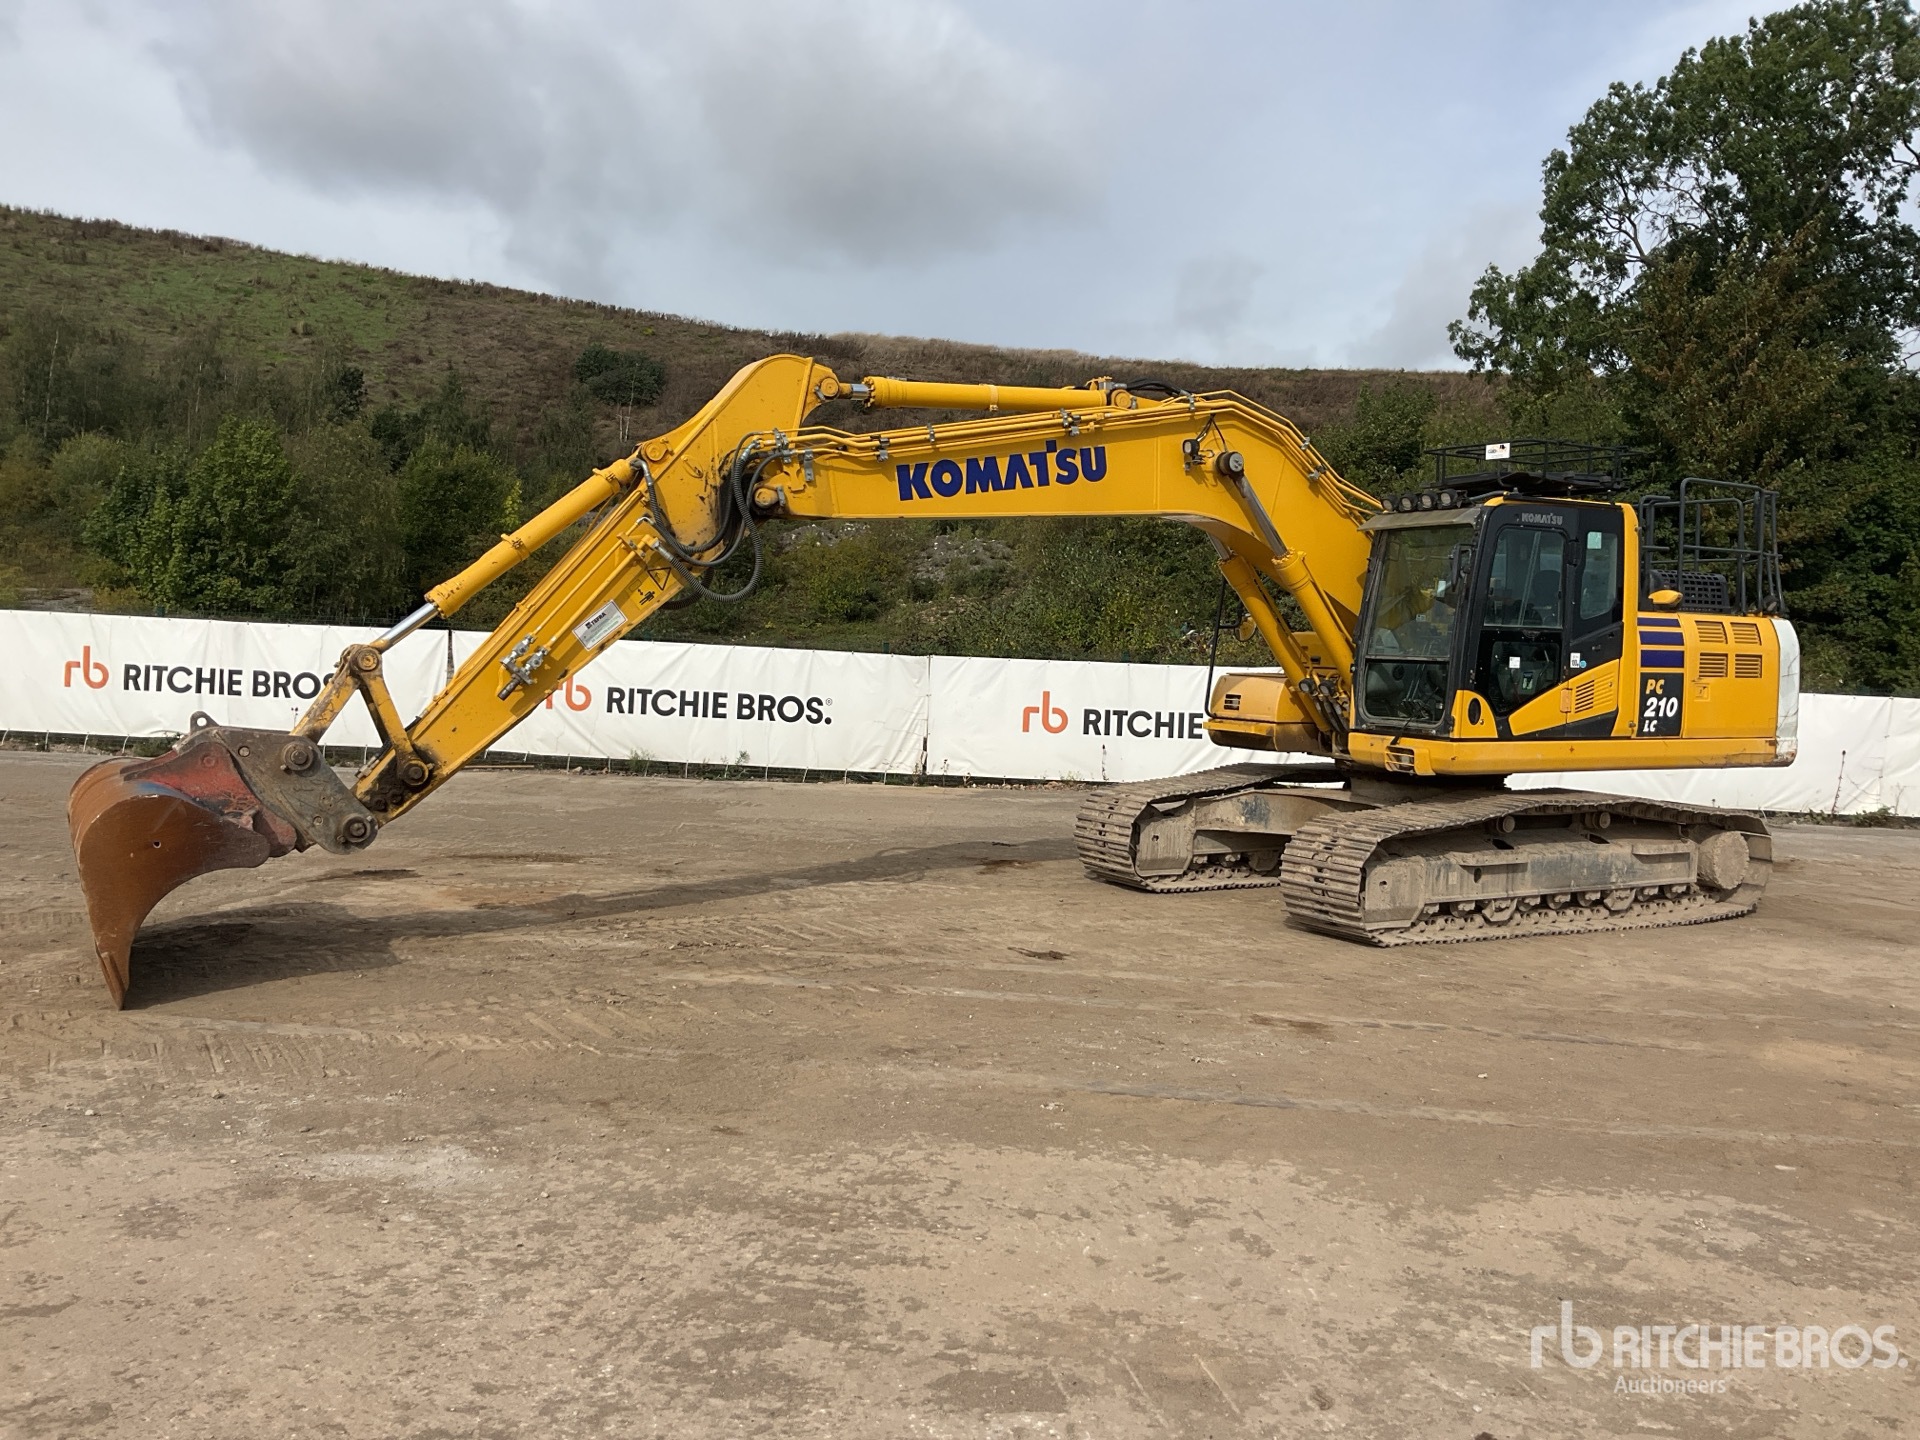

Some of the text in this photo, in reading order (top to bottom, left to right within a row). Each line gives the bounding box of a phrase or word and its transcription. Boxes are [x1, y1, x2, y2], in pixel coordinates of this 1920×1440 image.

[896, 440, 1107, 501] KOMATSU
[1521, 512, 1563, 525] KOMATSU
[123, 664, 243, 696] RITCHIE
[1645, 679, 1665, 694] PC
[606, 687, 728, 719] RITCHIE
[1643, 697, 1678, 717] 210
[1083, 708, 1203, 739] RITCHIE
[1643, 720, 1658, 732] LC
